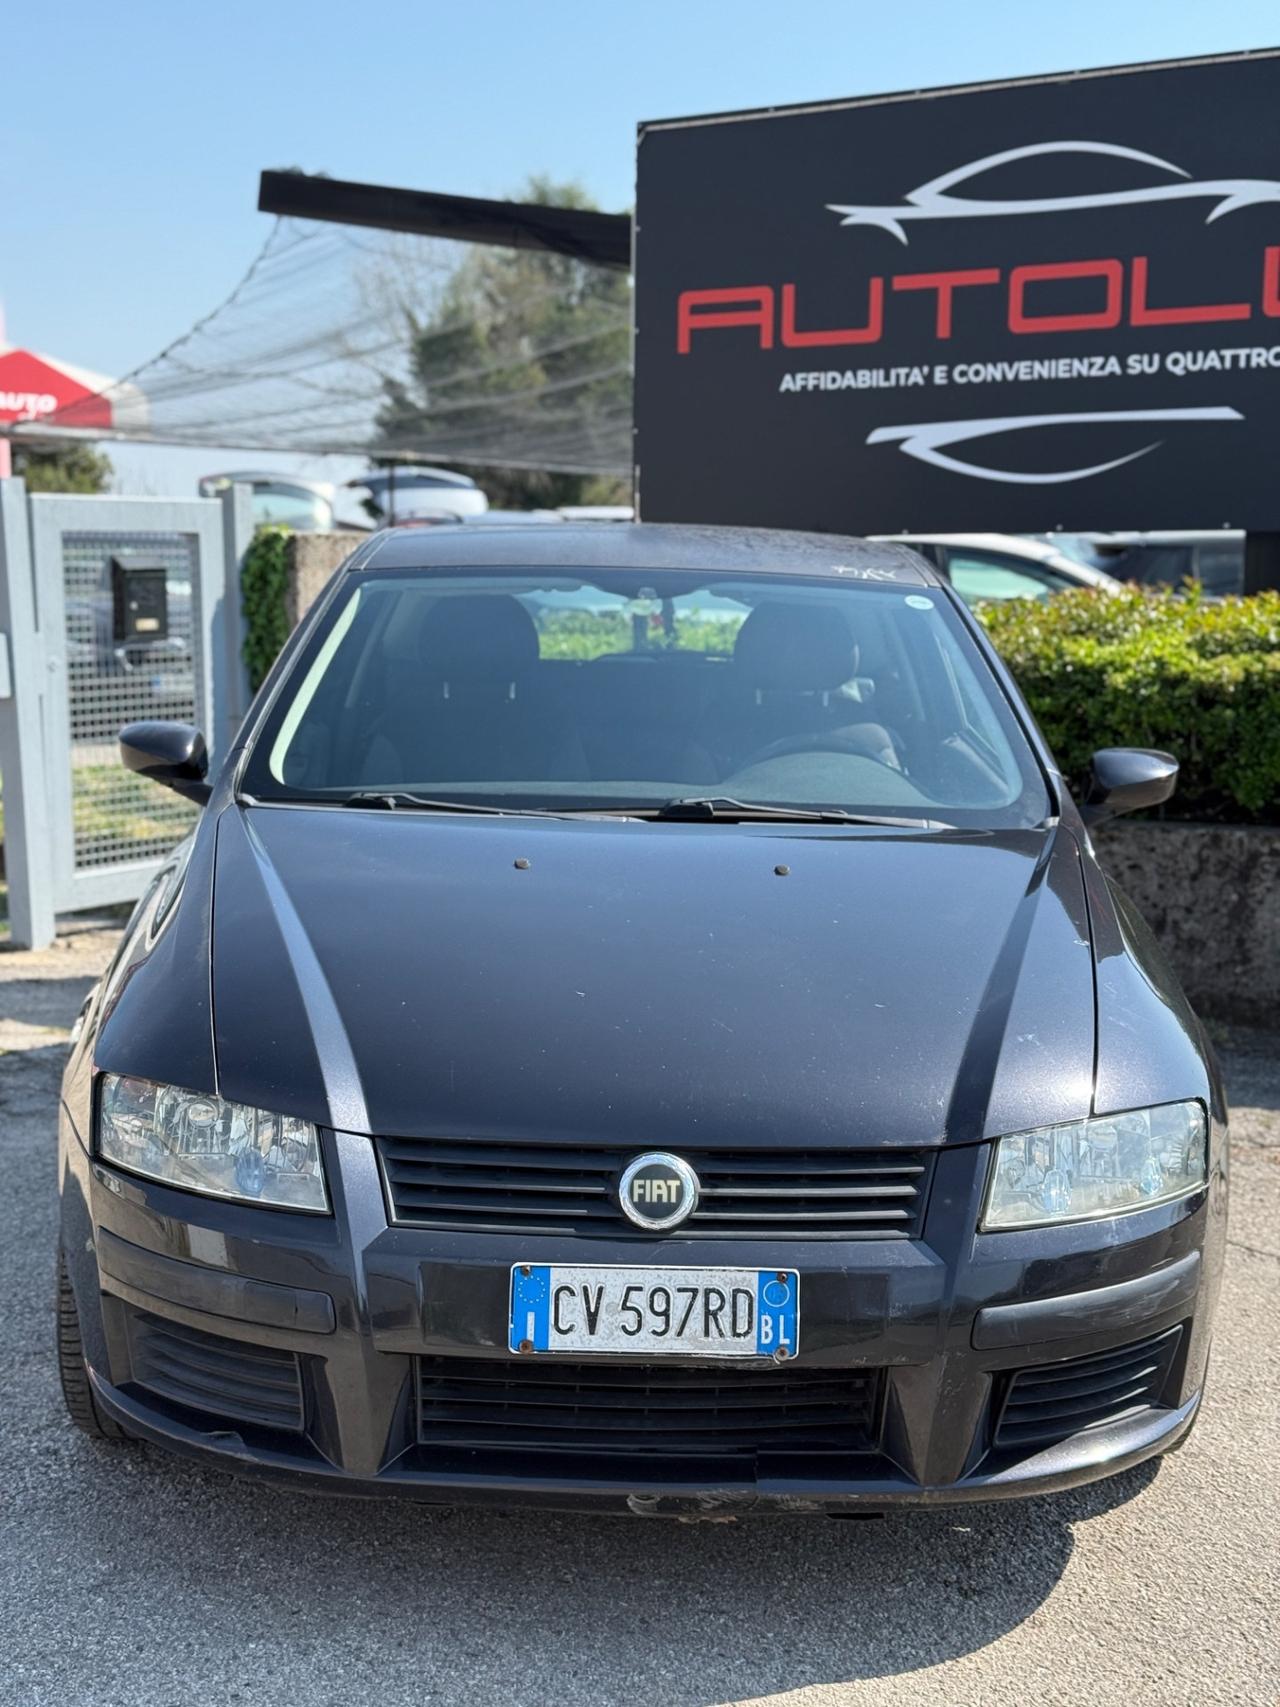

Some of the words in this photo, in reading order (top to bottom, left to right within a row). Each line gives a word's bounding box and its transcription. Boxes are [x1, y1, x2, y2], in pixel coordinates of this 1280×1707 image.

[779, 365, 929, 392] AFFIDABILITA'
[934, 365, 948, 385] E
[953, 356, 1121, 384] CONVENIENZA
[1126, 353, 1160, 375] SU
[632, 1179, 681, 1203] FIAT
[554, 1285, 604, 1336] CV
[620, 1286, 755, 1338] 597RD
[760, 1314, 790, 1345] BL
